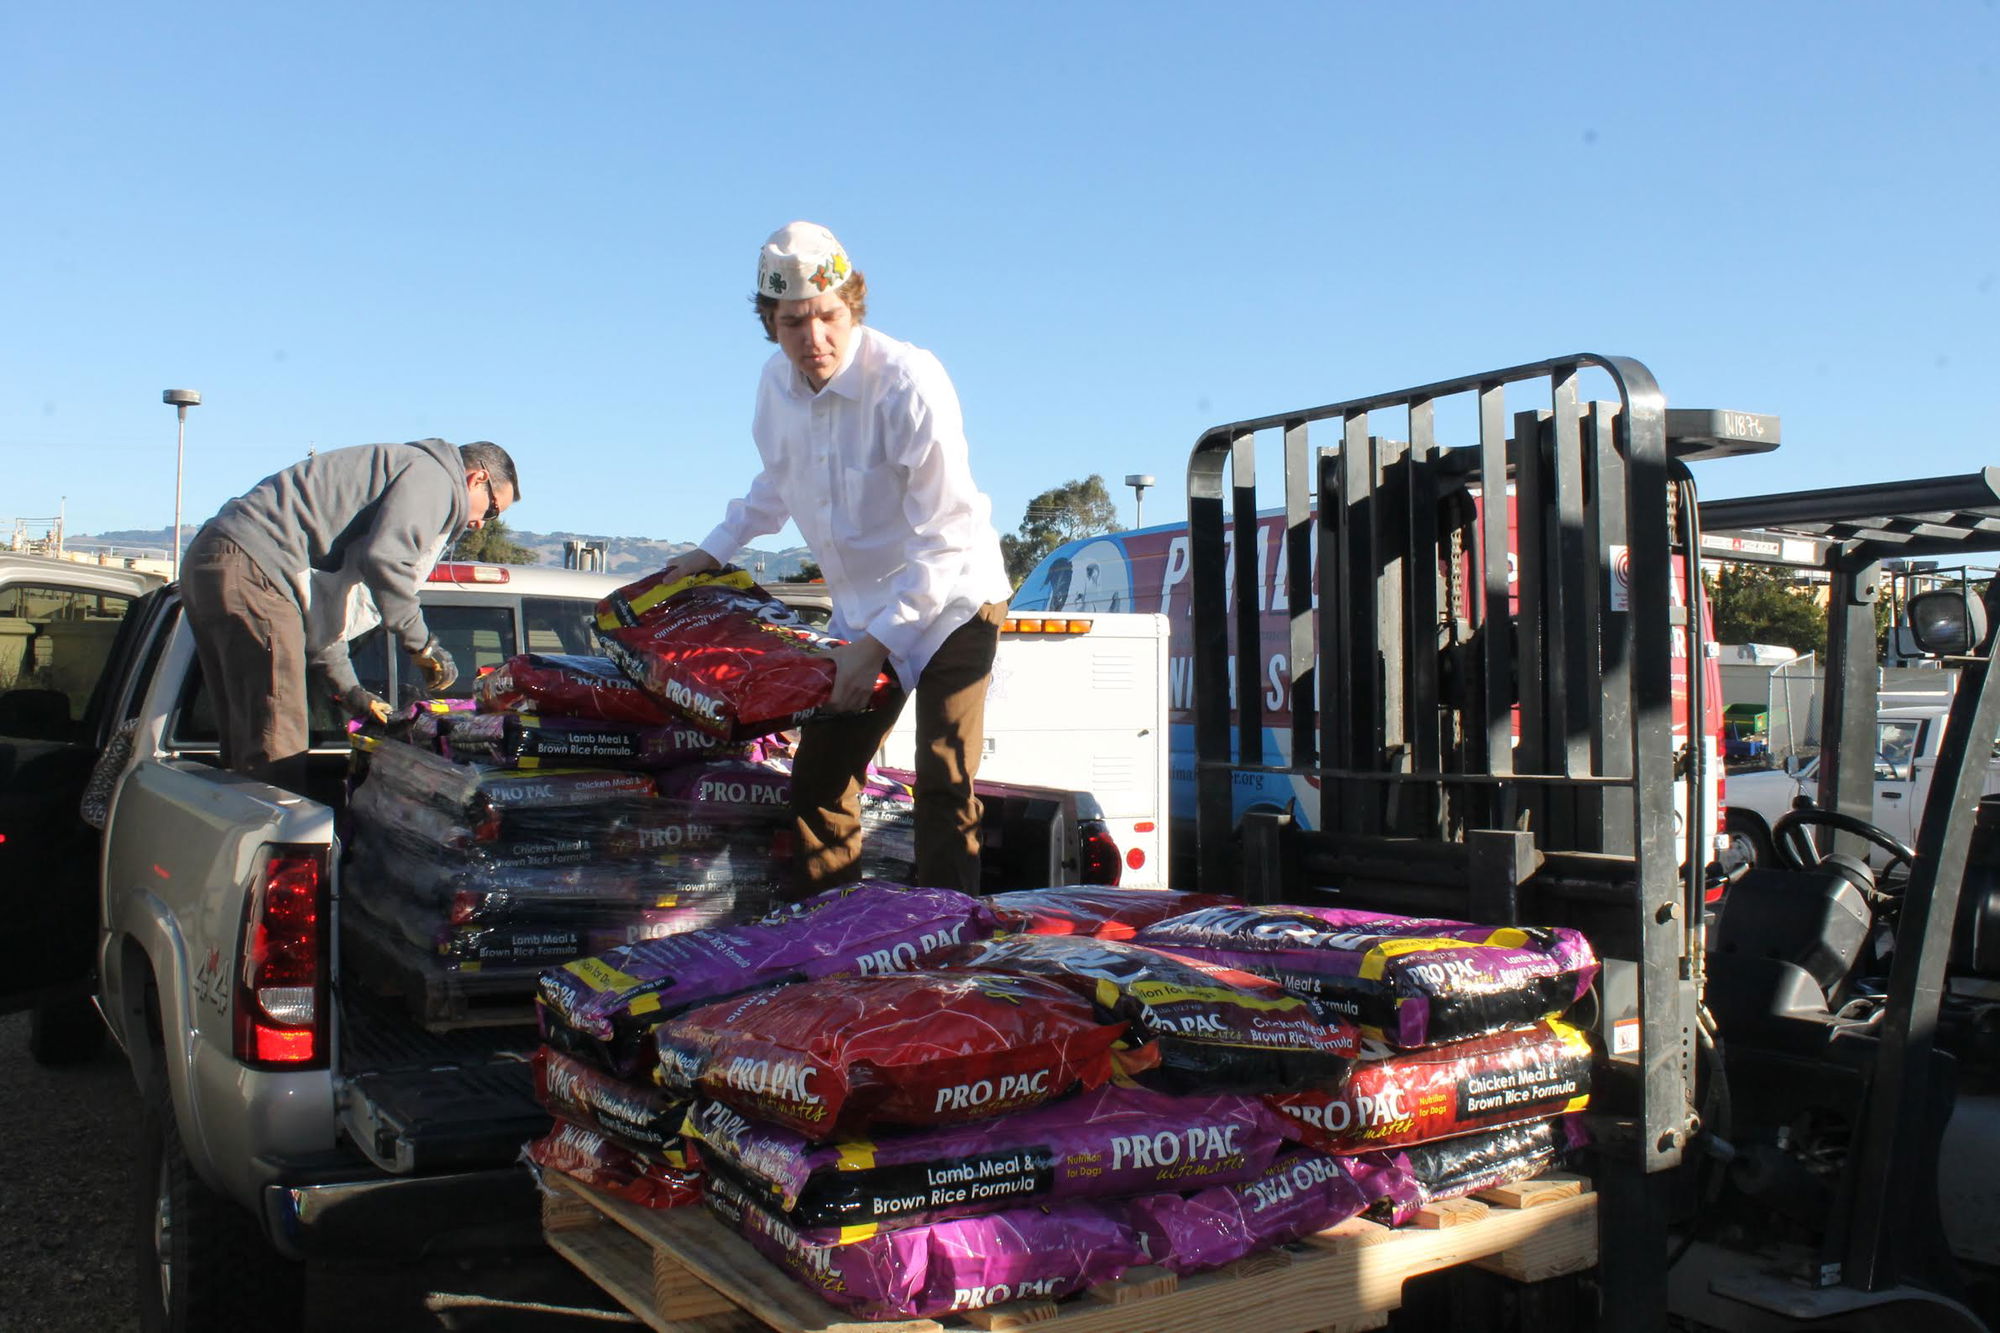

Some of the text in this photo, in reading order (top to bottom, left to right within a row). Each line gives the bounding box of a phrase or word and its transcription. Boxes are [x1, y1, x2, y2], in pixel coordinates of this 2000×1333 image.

[665, 678, 692, 708] PRO
[693, 691, 726, 720] PAC
[538, 743, 631, 756] Brown Rice Formula
[568, 733, 630, 744] Lamb Meal &
[701, 781, 790, 805] PRO PAC
[512, 843, 554, 856] Chicken
[557, 840, 582, 851] Meal
[638, 825, 682, 849] PRO
[480, 945, 577, 958] Brown Rice Formula
[512, 935, 540, 945] Lamb
[543, 934, 568, 944] Meal
[856, 942, 917, 977] PRO
[1503, 953, 1531, 964] Lamb
[1284, 975, 1312, 991] Meal
[1313, 979, 1321, 992] &
[1406, 963, 1445, 985] PRO
[1443, 958, 1482, 980] PAC
[1180, 1013, 1228, 1032] PAC
[1329, 1024, 1339, 1034] &
[1250, 1029, 1286, 1043] Brown
[726, 1056, 820, 1104] PRO PAC
[934, 1069, 1050, 1113] PRO PAC
[1468, 1067, 1557, 1095] Chicken Meal &
[1467, 1080, 1576, 1112] Brown Rice Formula
[1281, 1089, 1410, 1132] PRO PAC
[1430, 1105, 1447, 1115] Dogs
[1067, 1153, 1102, 1165] Nutrition
[1111, 1124, 1241, 1170] PRO PAC
[927, 1155, 1035, 1186] Lamb Meal &
[1067, 1167, 1102, 1178] for Dogs
[873, 1176, 1035, 1215] Brown Rice Formula
[1244, 1157, 1339, 1212] PRO PAC
[951, 1283, 1010, 1310] PRO
